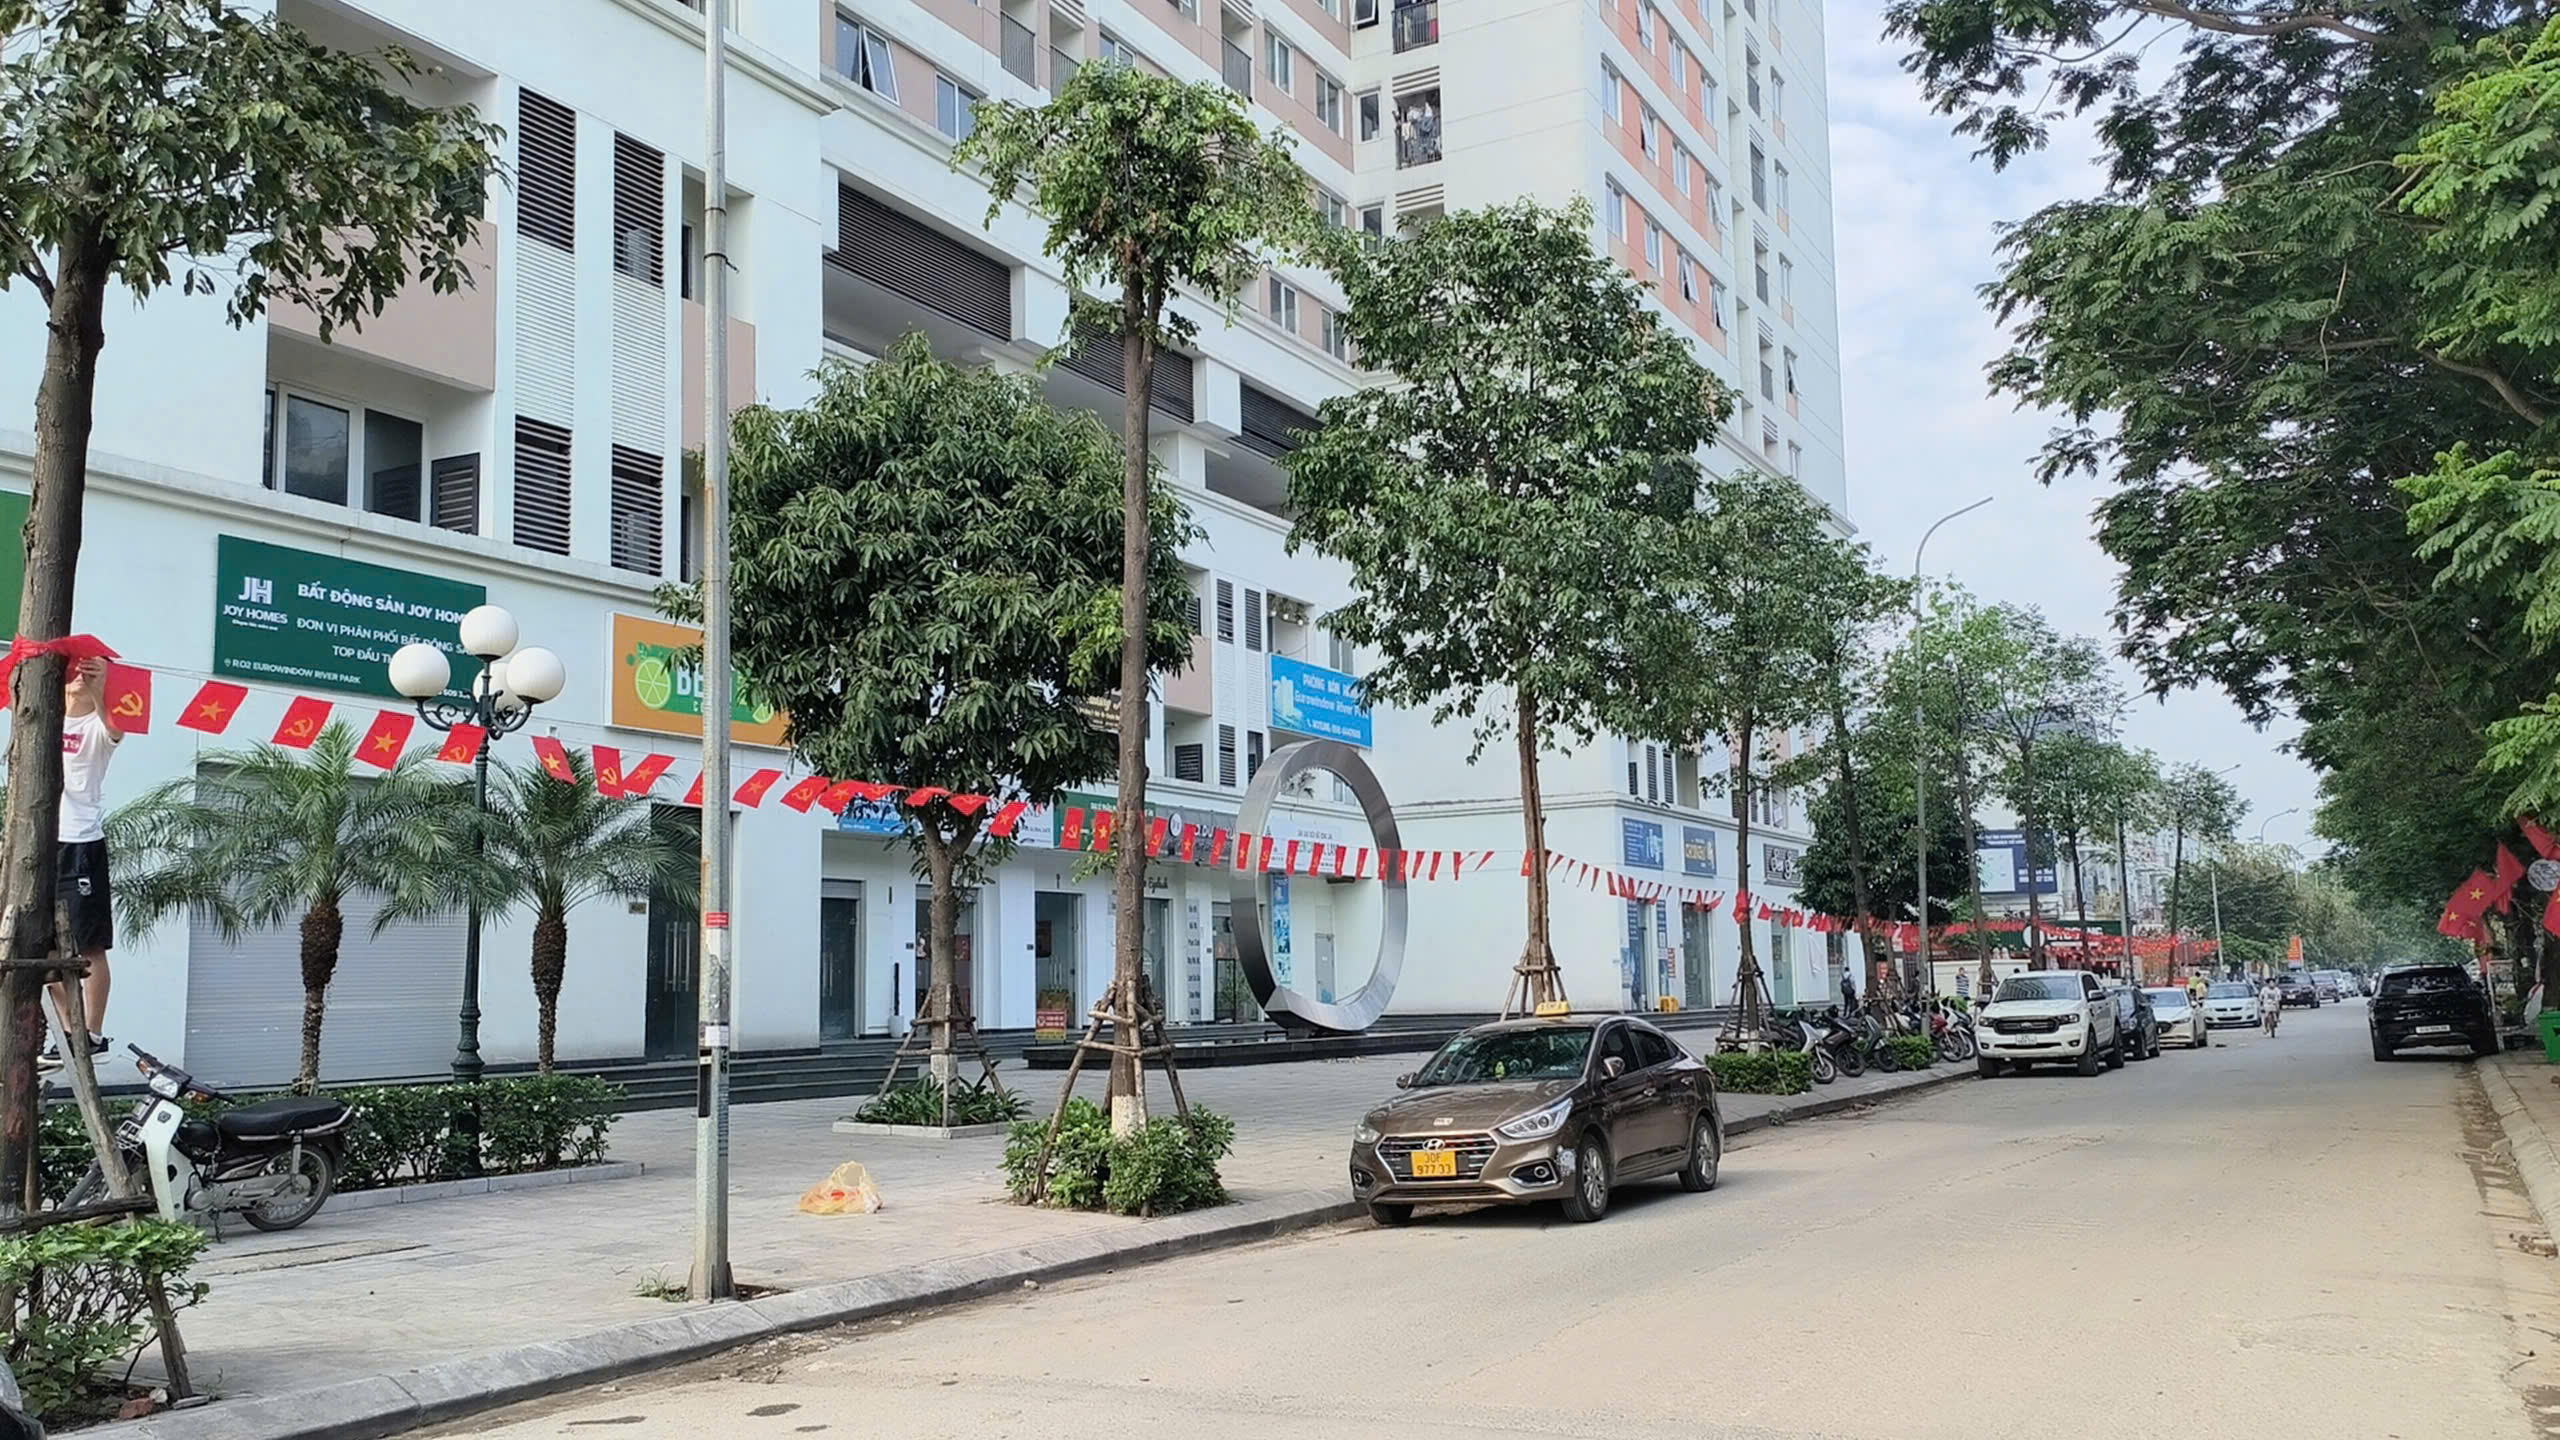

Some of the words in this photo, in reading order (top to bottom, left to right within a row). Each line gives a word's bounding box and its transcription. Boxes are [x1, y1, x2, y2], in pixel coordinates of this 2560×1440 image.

[238, 576, 273, 605] JH
[297, 581, 328, 600] BẤT
[329, 588, 373, 609] ĐỘNG
[375, 594, 404, 614] SẢN
[407, 606, 433, 619] JOY
[435, 608, 465, 624] HOM
[223, 604, 245, 617] JOY
[246, 608, 288, 624] HOMES
[326, 622, 338, 637] VỊ
[340, 625, 371, 639] PHÂN
[373, 628, 399, 644] PHỐI
[332, 645, 355, 658] TOP
[252, 662, 314, 677] EUROWINDOW
[314, 670, 338, 681] RIVER
[339, 673, 361, 684] PARK
